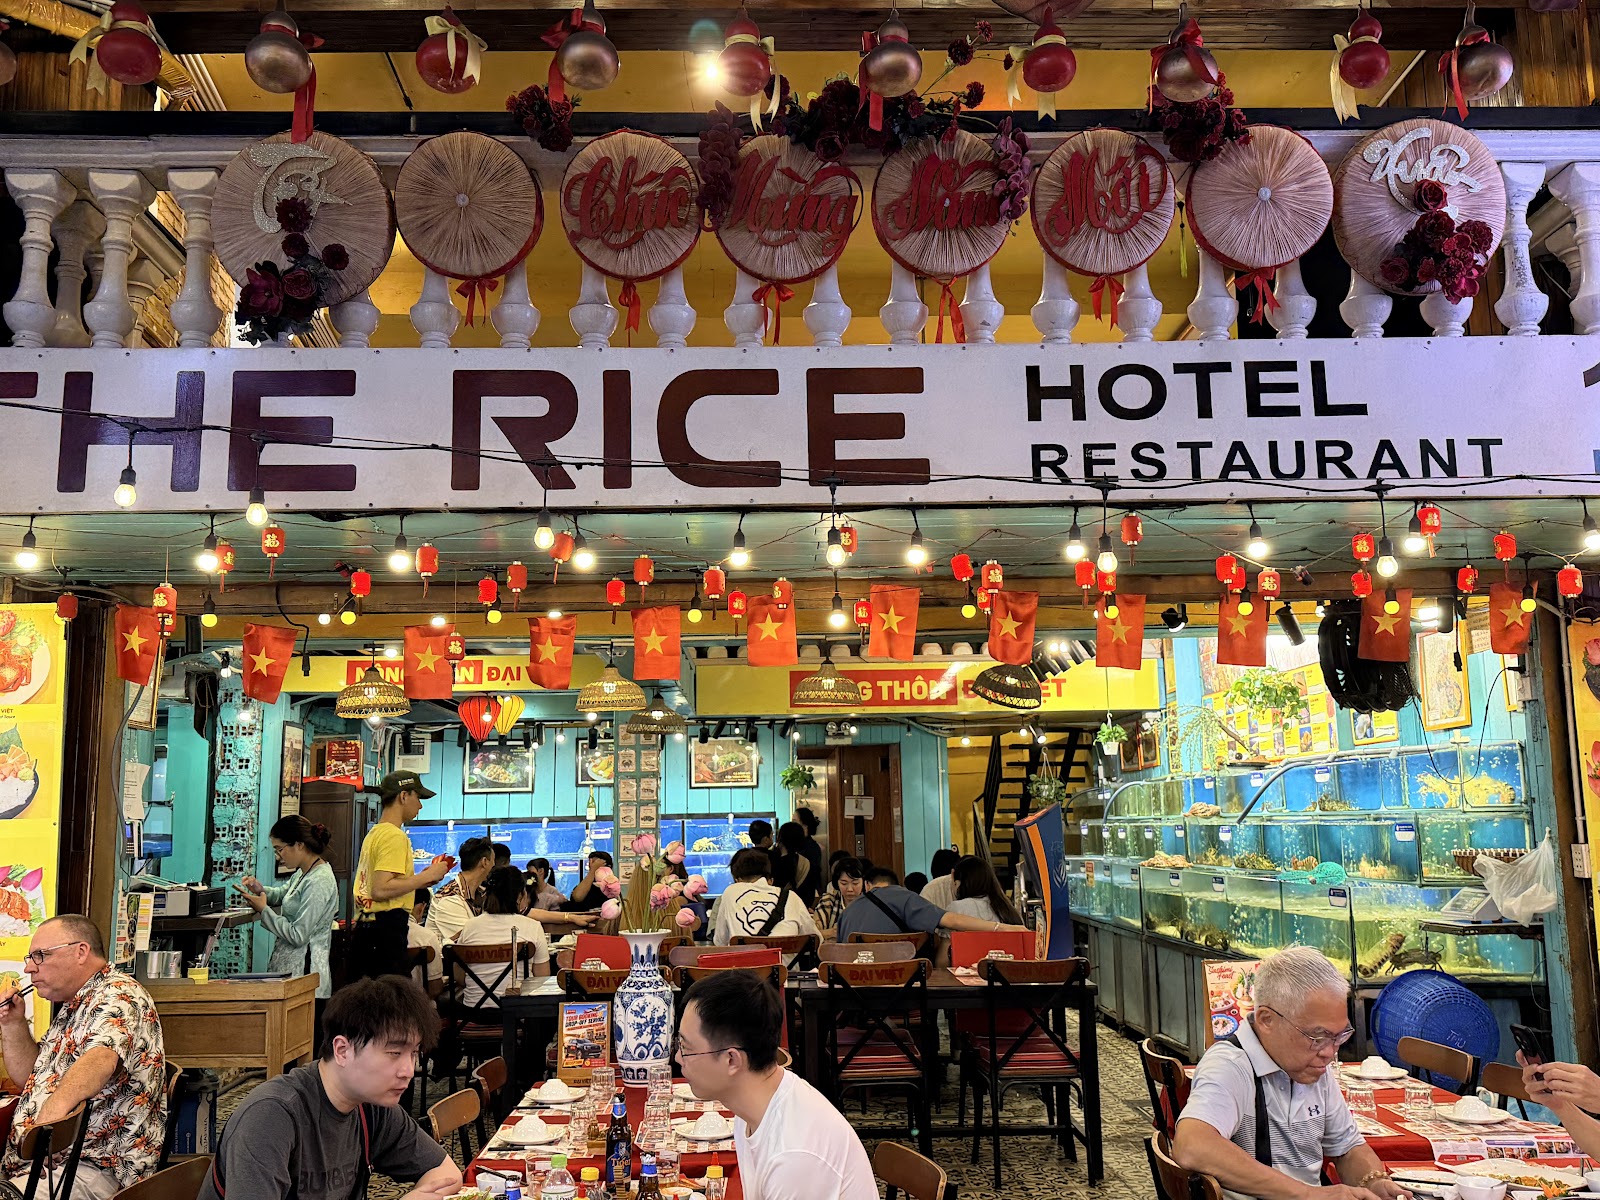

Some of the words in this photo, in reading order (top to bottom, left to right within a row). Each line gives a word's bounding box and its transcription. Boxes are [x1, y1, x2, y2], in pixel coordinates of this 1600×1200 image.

[563, 155, 693, 250] Chúc
[1025, 360, 1368, 421] HOTEL
[0, 369, 357, 492] HE
[451, 367, 931, 491] RICE
[1031, 438, 1504, 482] RESTAURANT
[448, 641, 462, 654] 福
[487, 666, 521, 686] ĐẠI
[586, 977, 611, 991] ĐẠI
[849, 970, 873, 983] ĐẠI
[875, 966, 905, 982] VIỆT
